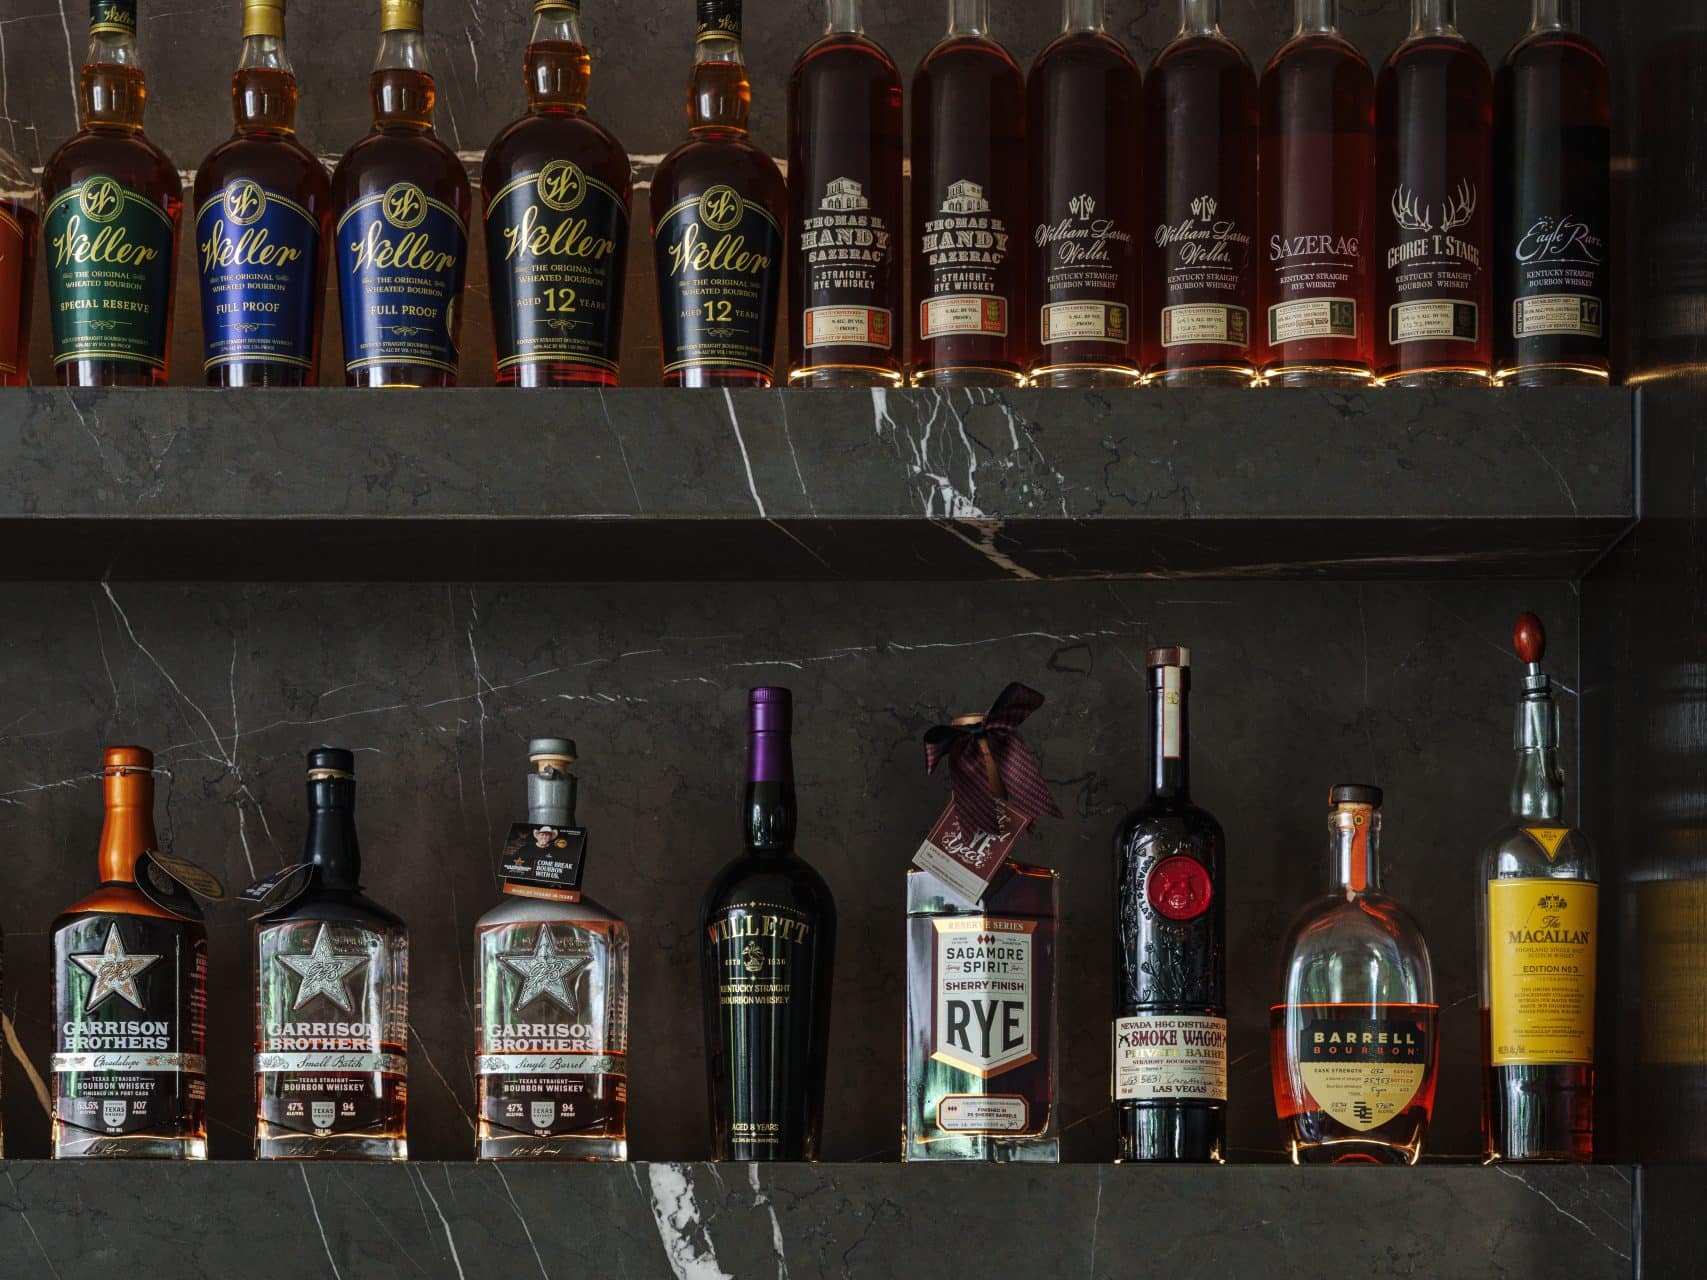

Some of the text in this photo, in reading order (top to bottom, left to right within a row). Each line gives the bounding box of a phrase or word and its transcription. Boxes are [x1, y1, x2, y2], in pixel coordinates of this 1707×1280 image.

[804, 215, 868, 230] THOMAS
[925, 217, 988, 233] THOMAS
[504, 205, 616, 262] Weller
[801, 228, 889, 250] HANDY
[1035, 218, 1089, 248] William
[1155, 219, 1210, 248] William
[53, 215, 158, 268] Weller
[202, 219, 301, 273] Weller
[351, 220, 456, 274] Weller
[922, 230, 1009, 254] HANDY
[1270, 234, 1360, 260] SAZERAC
[668, 223, 771, 277] Weller
[808, 249, 882, 263] SAZERAC
[1387, 234, 1481, 270] GEORGE T. STAGG
[929, 251, 1001, 266] SAZERAC
[92, 271, 130, 279] ORIGINAL
[531, 264, 592, 274] THE ORIGINAL
[822, 270, 867, 280] STRAIGHT
[1527, 269, 1594, 279] KENTUCKY STRAIGHT
[236, 273, 273, 281] ORIGINAL
[394, 277, 432, 286] ORIGINAL
[519, 275, 603, 286] WHEATED BOURBON
[710, 279, 748, 287] ORIGINAL
[943, 272, 987, 282] STRAIGHT
[1048, 272, 1119, 284] KENTUCKY STRAIGHT
[1168, 273, 1239, 284] KENTUCKY STRAIGHT
[1280, 273, 1349, 284] KENTUCKY STRAIGHT
[1395, 271, 1472, 284] KENTUCKY STRAIGHT
[1529, 278, 1592, 287] BOURBON WHISKEY
[65, 280, 142, 290] WHEATED BOURBON
[212, 283, 285, 293] WHEATED BOURBON
[814, 279, 875, 290] RYE WHISKEY
[934, 281, 995, 292] RYE WHISKEY
[1050, 280, 1116, 291] BOURBON WHISKEY
[1170, 282, 1237, 291] BOURBON WHISKEY
[1398, 280, 1469, 291] BOURBON WHISKEY
[407, 287, 442, 297] BOURBON
[682, 288, 758, 298] WHEATED BOURBON
[60, 300, 149, 312] SPECIAL RESERVE
[517, 288, 605, 312] AGED 12 YEARS
[216, 302, 280, 314] FULL PROOF
[371, 305, 437, 318] FULL PROOF
[681, 300, 759, 322] AGED 12 YEARS
[1581, 301, 1598, 322] 17
[993, 922, 1023, 930] SERIES
[1541, 915, 1560, 928] The
[707, 915, 809, 944] WILLETT
[1508, 929, 1590, 944] MACALLAN
[946, 947, 1023, 960] SAGAMORE
[963, 961, 1008, 973] SPIRIT
[1523, 965, 1559, 973] EDITION
[946, 981, 1024, 991] SHERRY FINISH
[720, 996, 754, 1004] BOURBON
[63, 1021, 169, 1036] GARRISON
[267, 1022, 380, 1037] GARRISON
[489, 1024, 601, 1037] GARRISON
[946, 1000, 1024, 1058] RYE
[1121, 1022, 1153, 1030] NEVADA
[64, 1036, 169, 1050] BROTHERS
[269, 1038, 380, 1051] BROTHERS
[1131, 1030, 1222, 1048] SMOKE WAGON
[1314, 1032, 1415, 1045] BARRELL
[490, 1039, 601, 1052] BROTHERS
[1314, 1046, 1415, 1055] BOURBON
[1125, 1048, 1179, 1058] PRIVATE
[93, 1055, 140, 1069] Guadalupe
[297, 1055, 364, 1068] Small Batch
[515, 1057, 587, 1071] Single Barrel
[78, 1082, 155, 1090] BOURBON WHISKEY
[1175, 1085, 1207, 1093] VEGAS
[133, 1101, 146, 1110] 107
[287, 1102, 304, 1111] 47%
[342, 1102, 354, 1111] 94
[507, 1103, 523, 1112] 47%
[562, 1103, 574, 1112] 94
